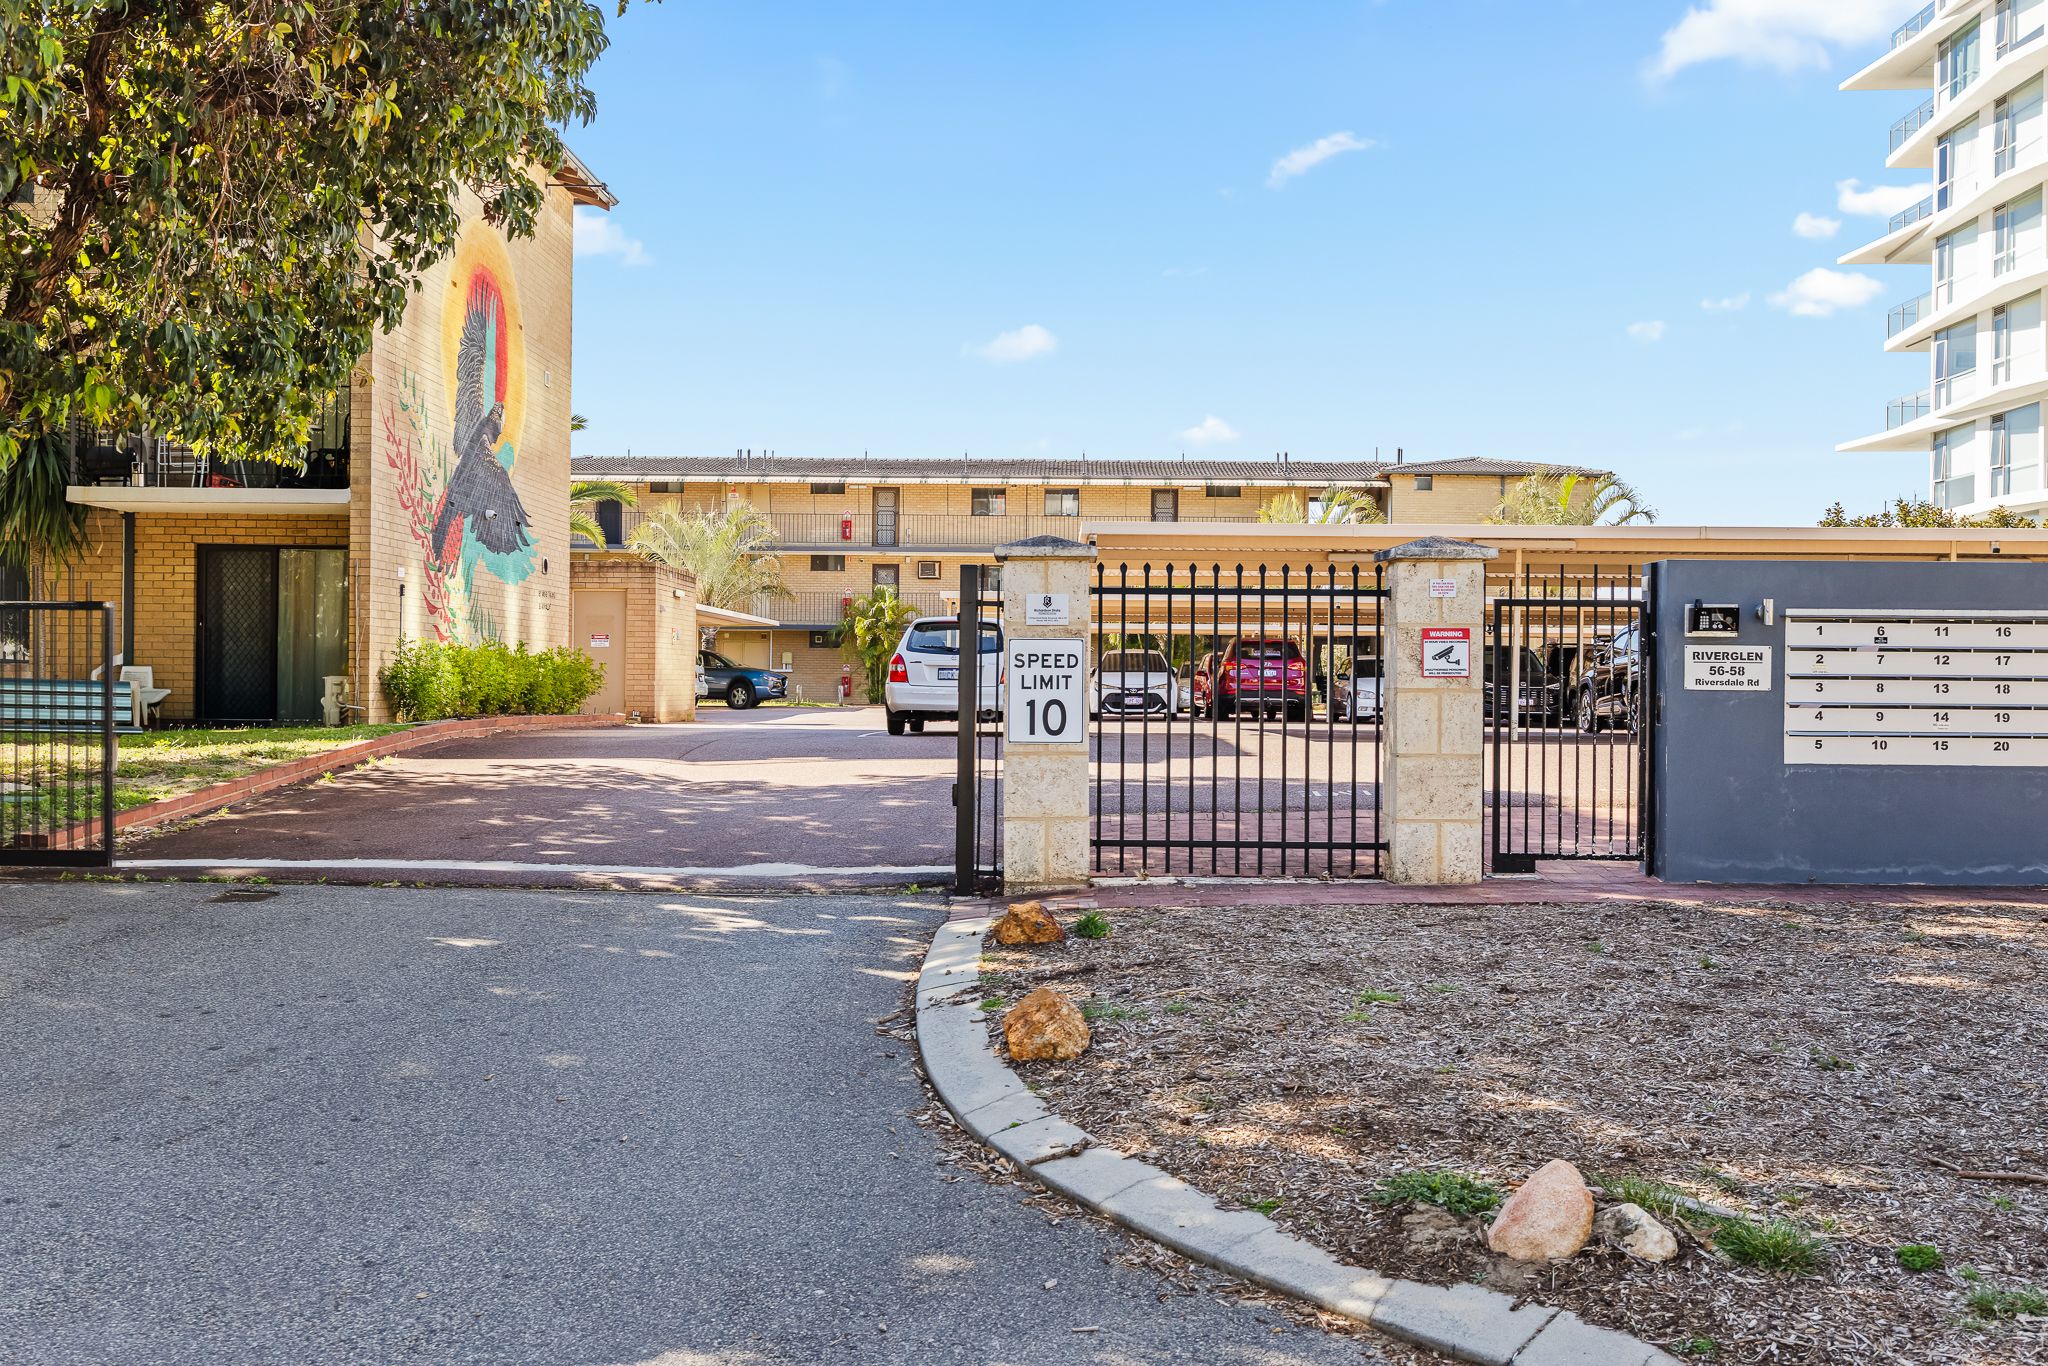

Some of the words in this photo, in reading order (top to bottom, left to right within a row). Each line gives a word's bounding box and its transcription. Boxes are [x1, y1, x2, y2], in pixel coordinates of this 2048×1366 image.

[1816, 626, 1823, 636] 1
[1877, 626, 1885, 637] 6
[1935, 627, 1948, 637] 11
[1996, 627, 2011, 638] 16
[1014, 653, 1078, 669] SPEED
[1693, 652, 1763, 661] RIVERGLEN
[1816, 654, 1823, 664] 2
[1877, 655, 1884, 665] 7
[1934, 655, 1949, 665] 12
[1995, 656, 2010, 666] 17
[1709, 666, 1745, 675] 56-58
[1021, 675, 1072, 689] LIMIT
[1816, 683, 1823, 693] 3
[1877, 683, 1884, 693] 8
[1934, 684, 1949, 694] 13
[1995, 684, 2010, 695] 18
[1026, 699, 1066, 736] 10
[1815, 711, 1823, 721] 4
[1876, 712, 1883, 722] 9
[1934, 712, 1949, 723] 14
[1995, 713, 2010, 723] 19
[1815, 740, 1822, 750] 5
[1872, 740, 1887, 751] 10
[1933, 741, 1948, 751] 15
[1994, 742, 2009, 752] 20
